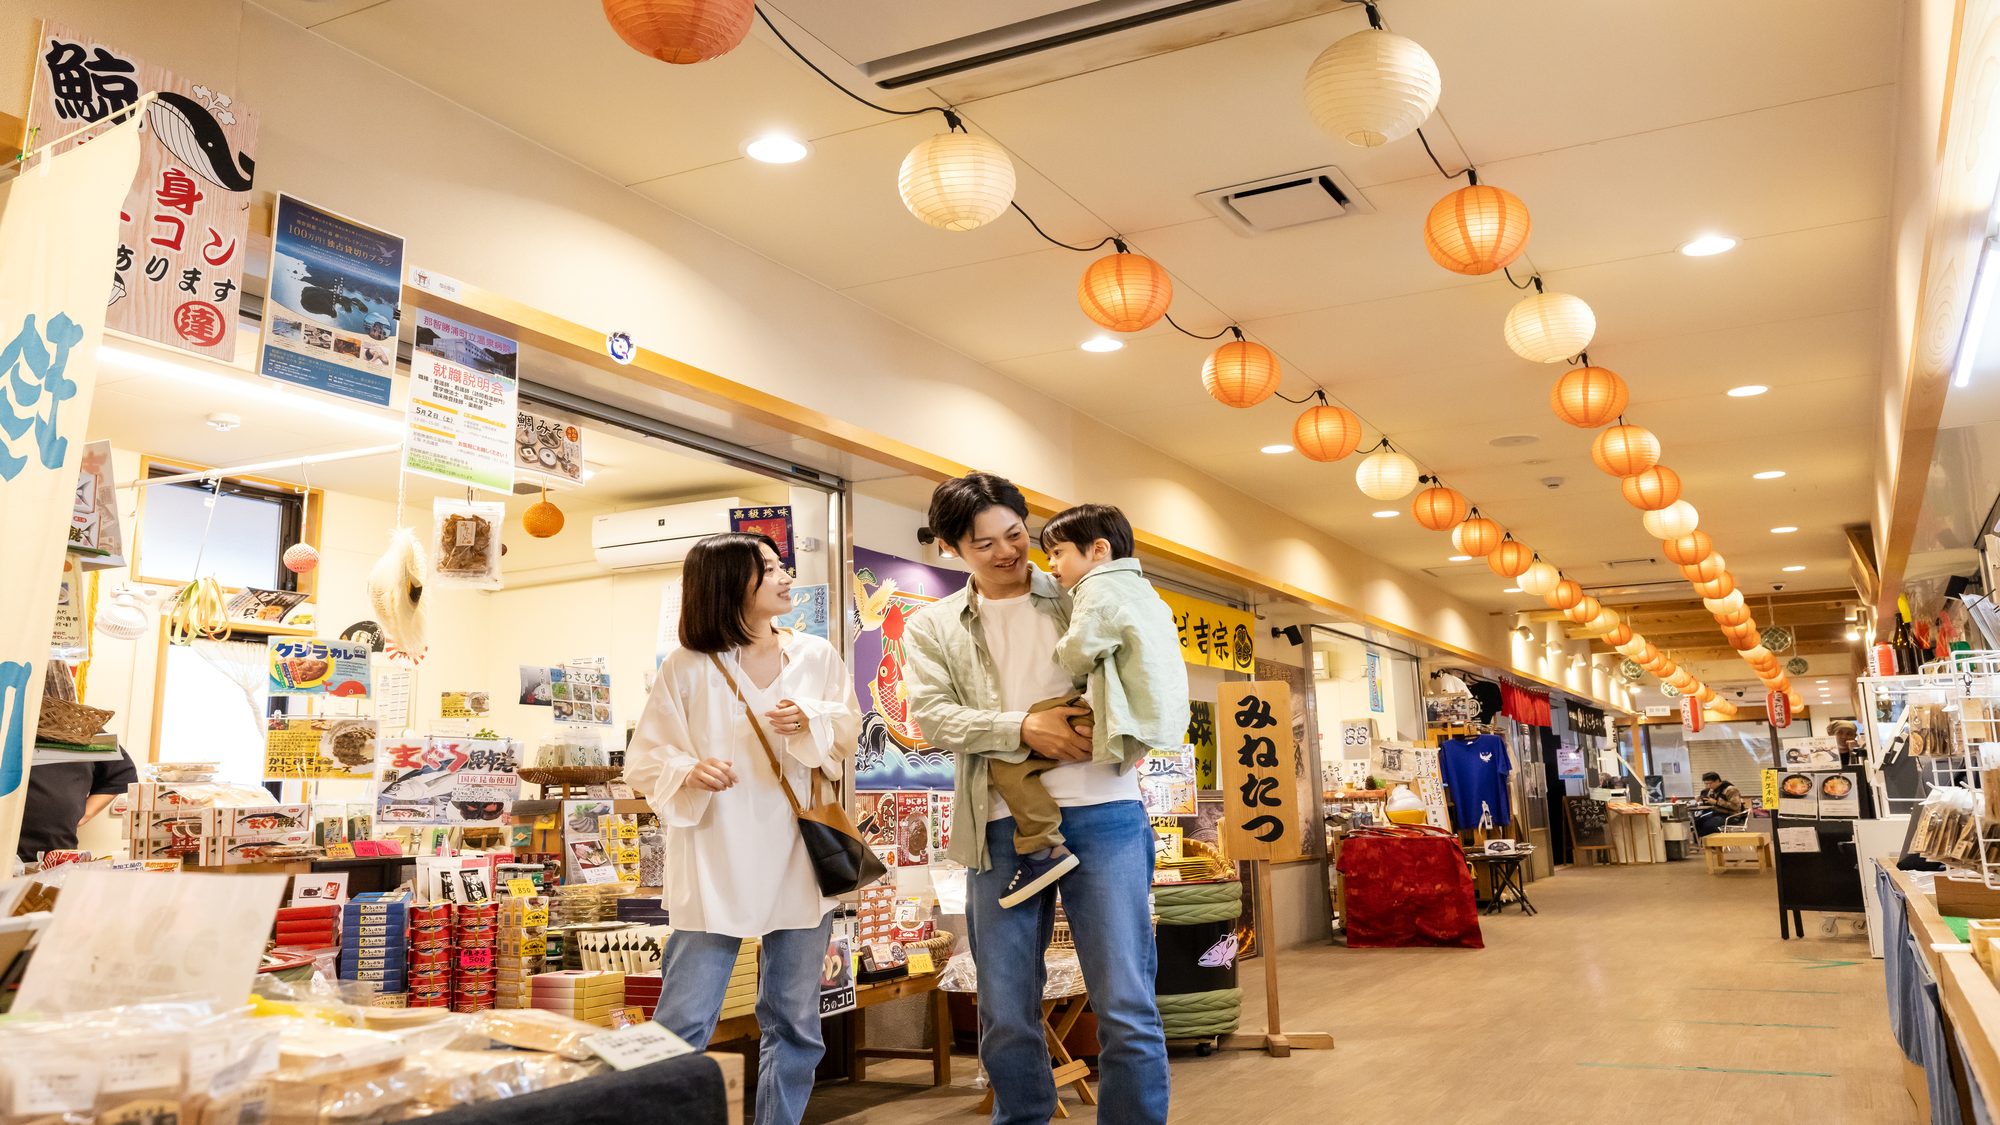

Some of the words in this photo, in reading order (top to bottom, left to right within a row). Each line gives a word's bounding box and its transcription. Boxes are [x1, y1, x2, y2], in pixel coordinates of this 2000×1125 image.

[46, 40, 143, 128] 鯨
[156, 168, 203, 215] 身
[121, 211, 236, 266] コン
[116, 244, 236, 302] あります
[423, 315, 512, 354] 那智勝浦町立温泉病院
[432, 362, 504, 397] 就職説明会
[517, 412, 563, 439] 鯛みそ
[734, 507, 789, 520] 高級珍味
[460, 775, 514, 785] 国産昆布使用
[1234, 694, 1284, 842] みねたつ
[517, 886, 532, 894] 850
